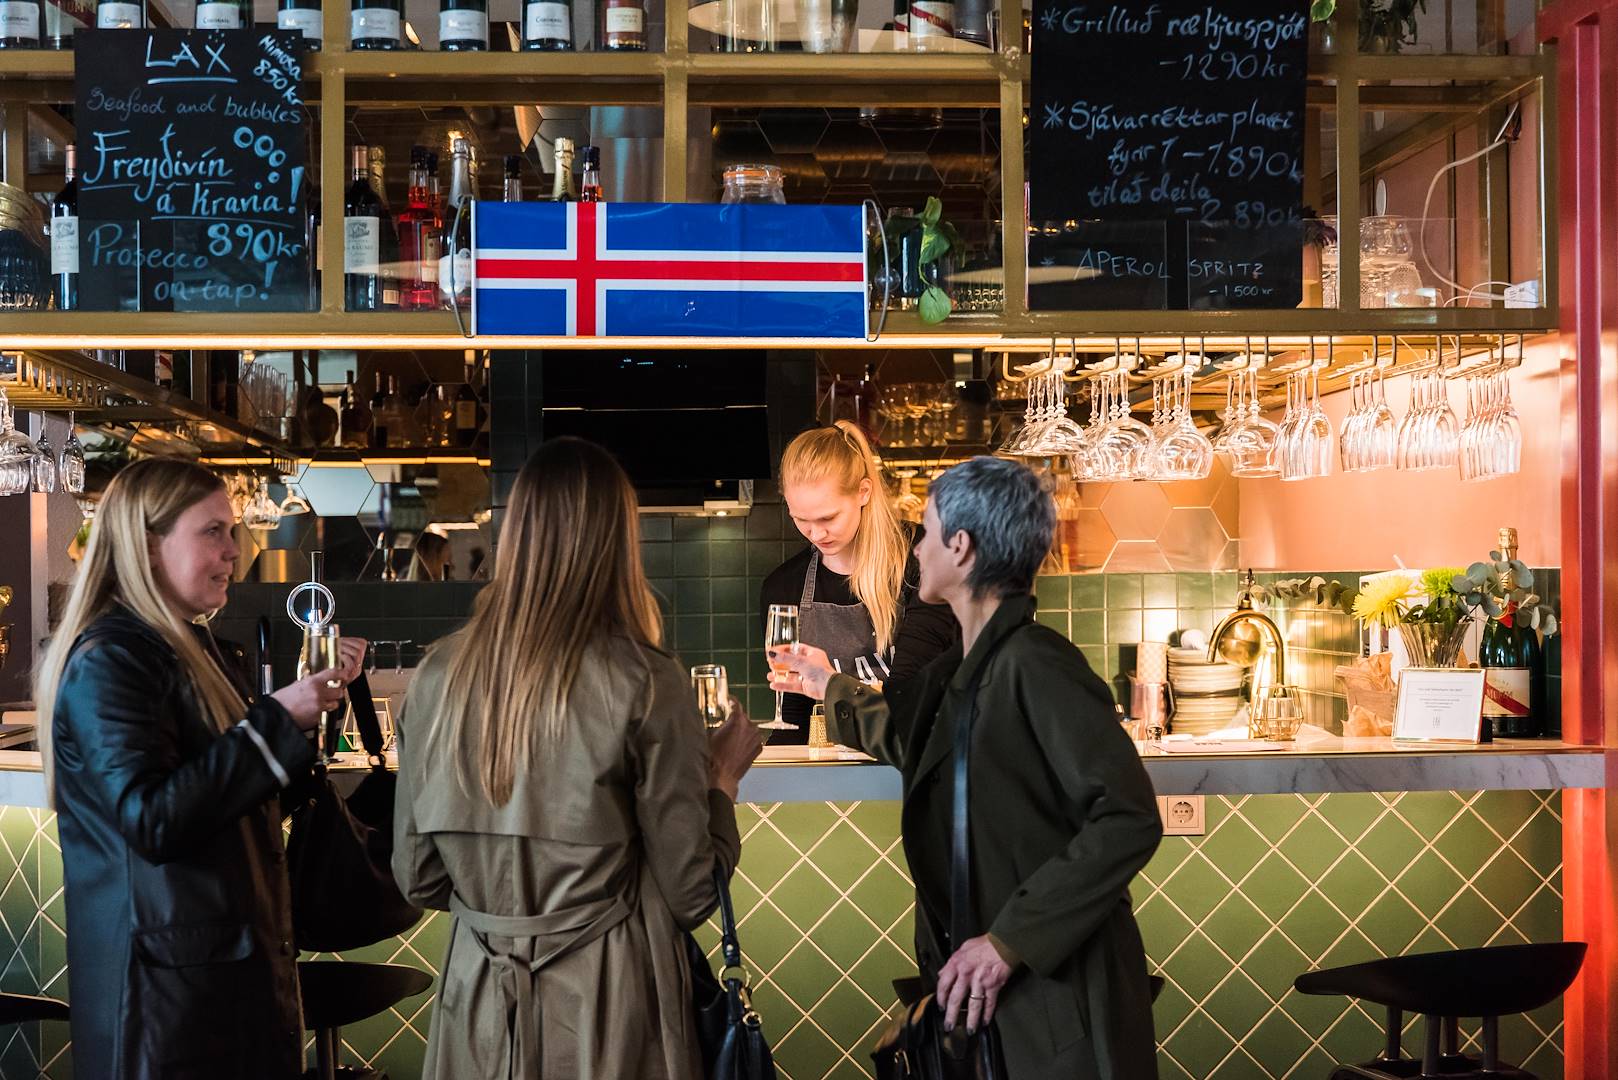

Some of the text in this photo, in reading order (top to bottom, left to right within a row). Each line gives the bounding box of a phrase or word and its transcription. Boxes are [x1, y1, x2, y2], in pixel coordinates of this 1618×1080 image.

[145, 35, 232, 73] LAX
[87, 87, 301, 124] Seafood and bubbles
[87, 223, 210, 268] Prosecco
[1073, 247, 1174, 280] APEROL
